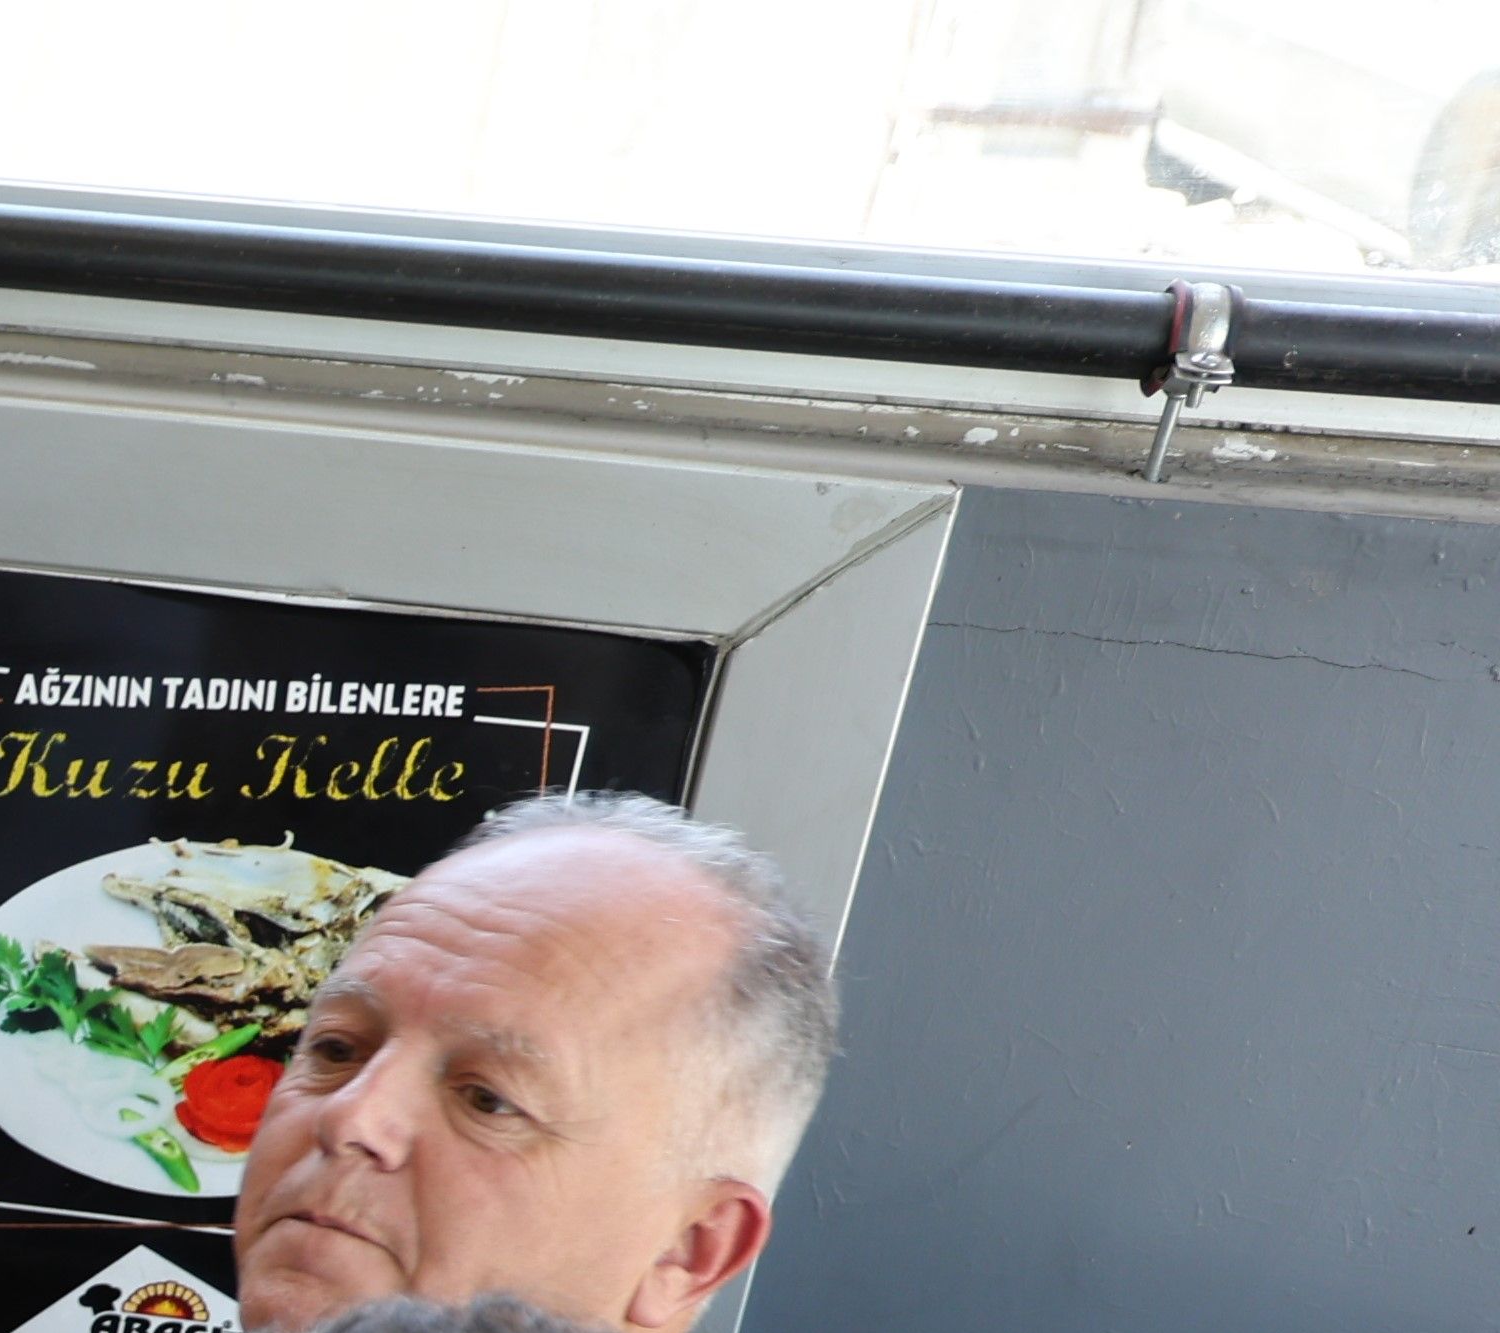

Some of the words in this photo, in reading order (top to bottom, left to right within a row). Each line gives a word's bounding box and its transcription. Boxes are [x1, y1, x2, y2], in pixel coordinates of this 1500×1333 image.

[14, 667, 153, 708] AĞZININ
[161, 677, 278, 712] TADINI
[285, 672, 466, 718] BİLENLERE
[240, 733, 465, 801] Kelle
